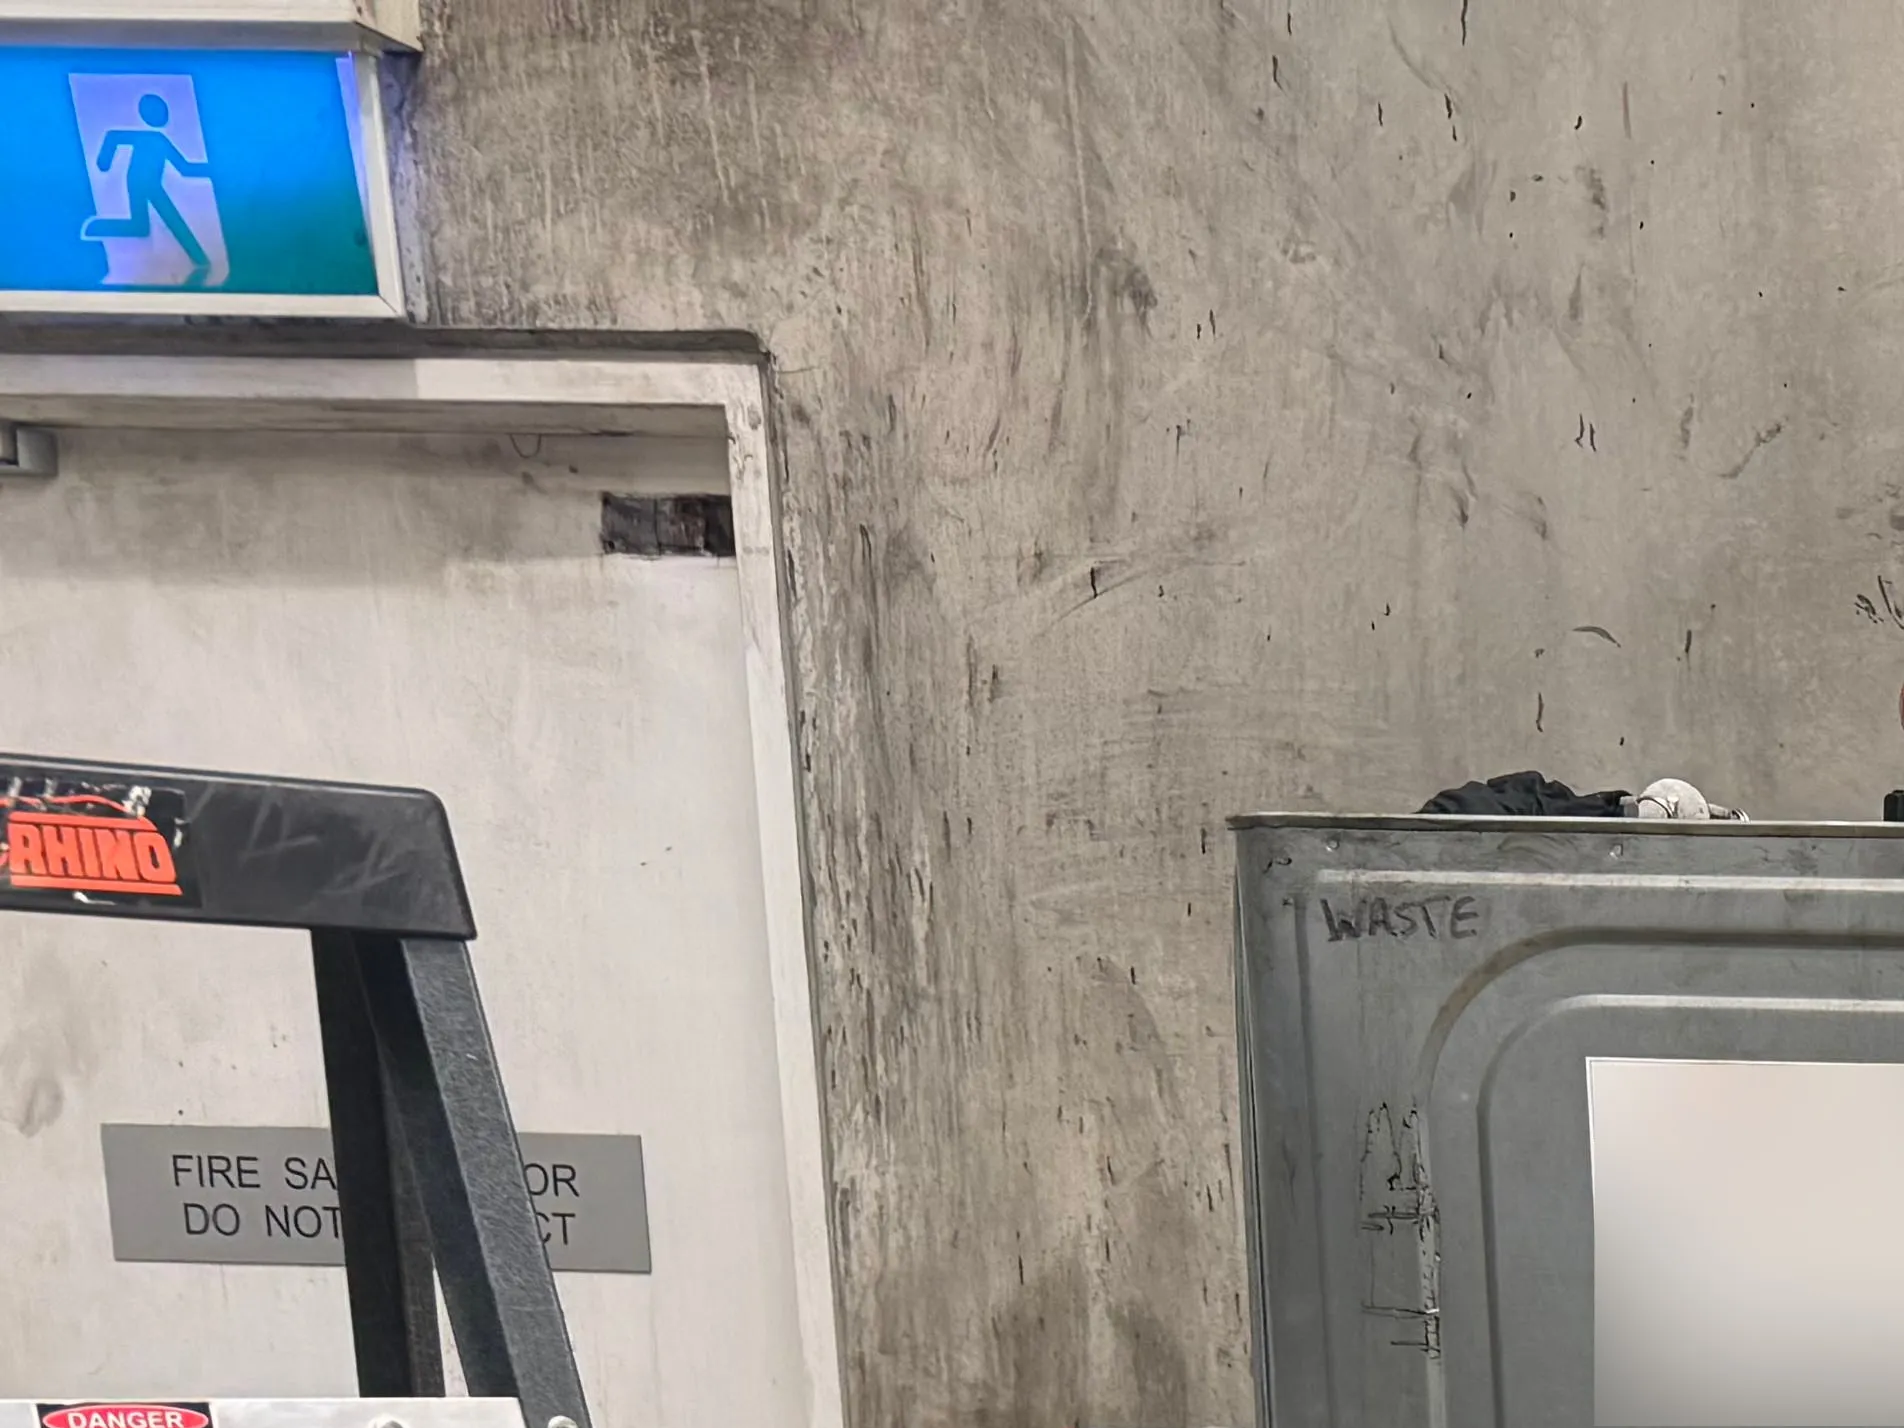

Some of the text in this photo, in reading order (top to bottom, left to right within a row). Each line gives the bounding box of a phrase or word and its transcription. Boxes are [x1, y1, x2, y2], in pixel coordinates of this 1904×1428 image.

[7, 823, 177, 882] RHINO
[1319, 895, 1479, 942] WASTE
[172, 1154, 260, 1189] FIRE
[524, 1163, 580, 1198] OR
[184, 1202, 343, 1240] DO NOT
